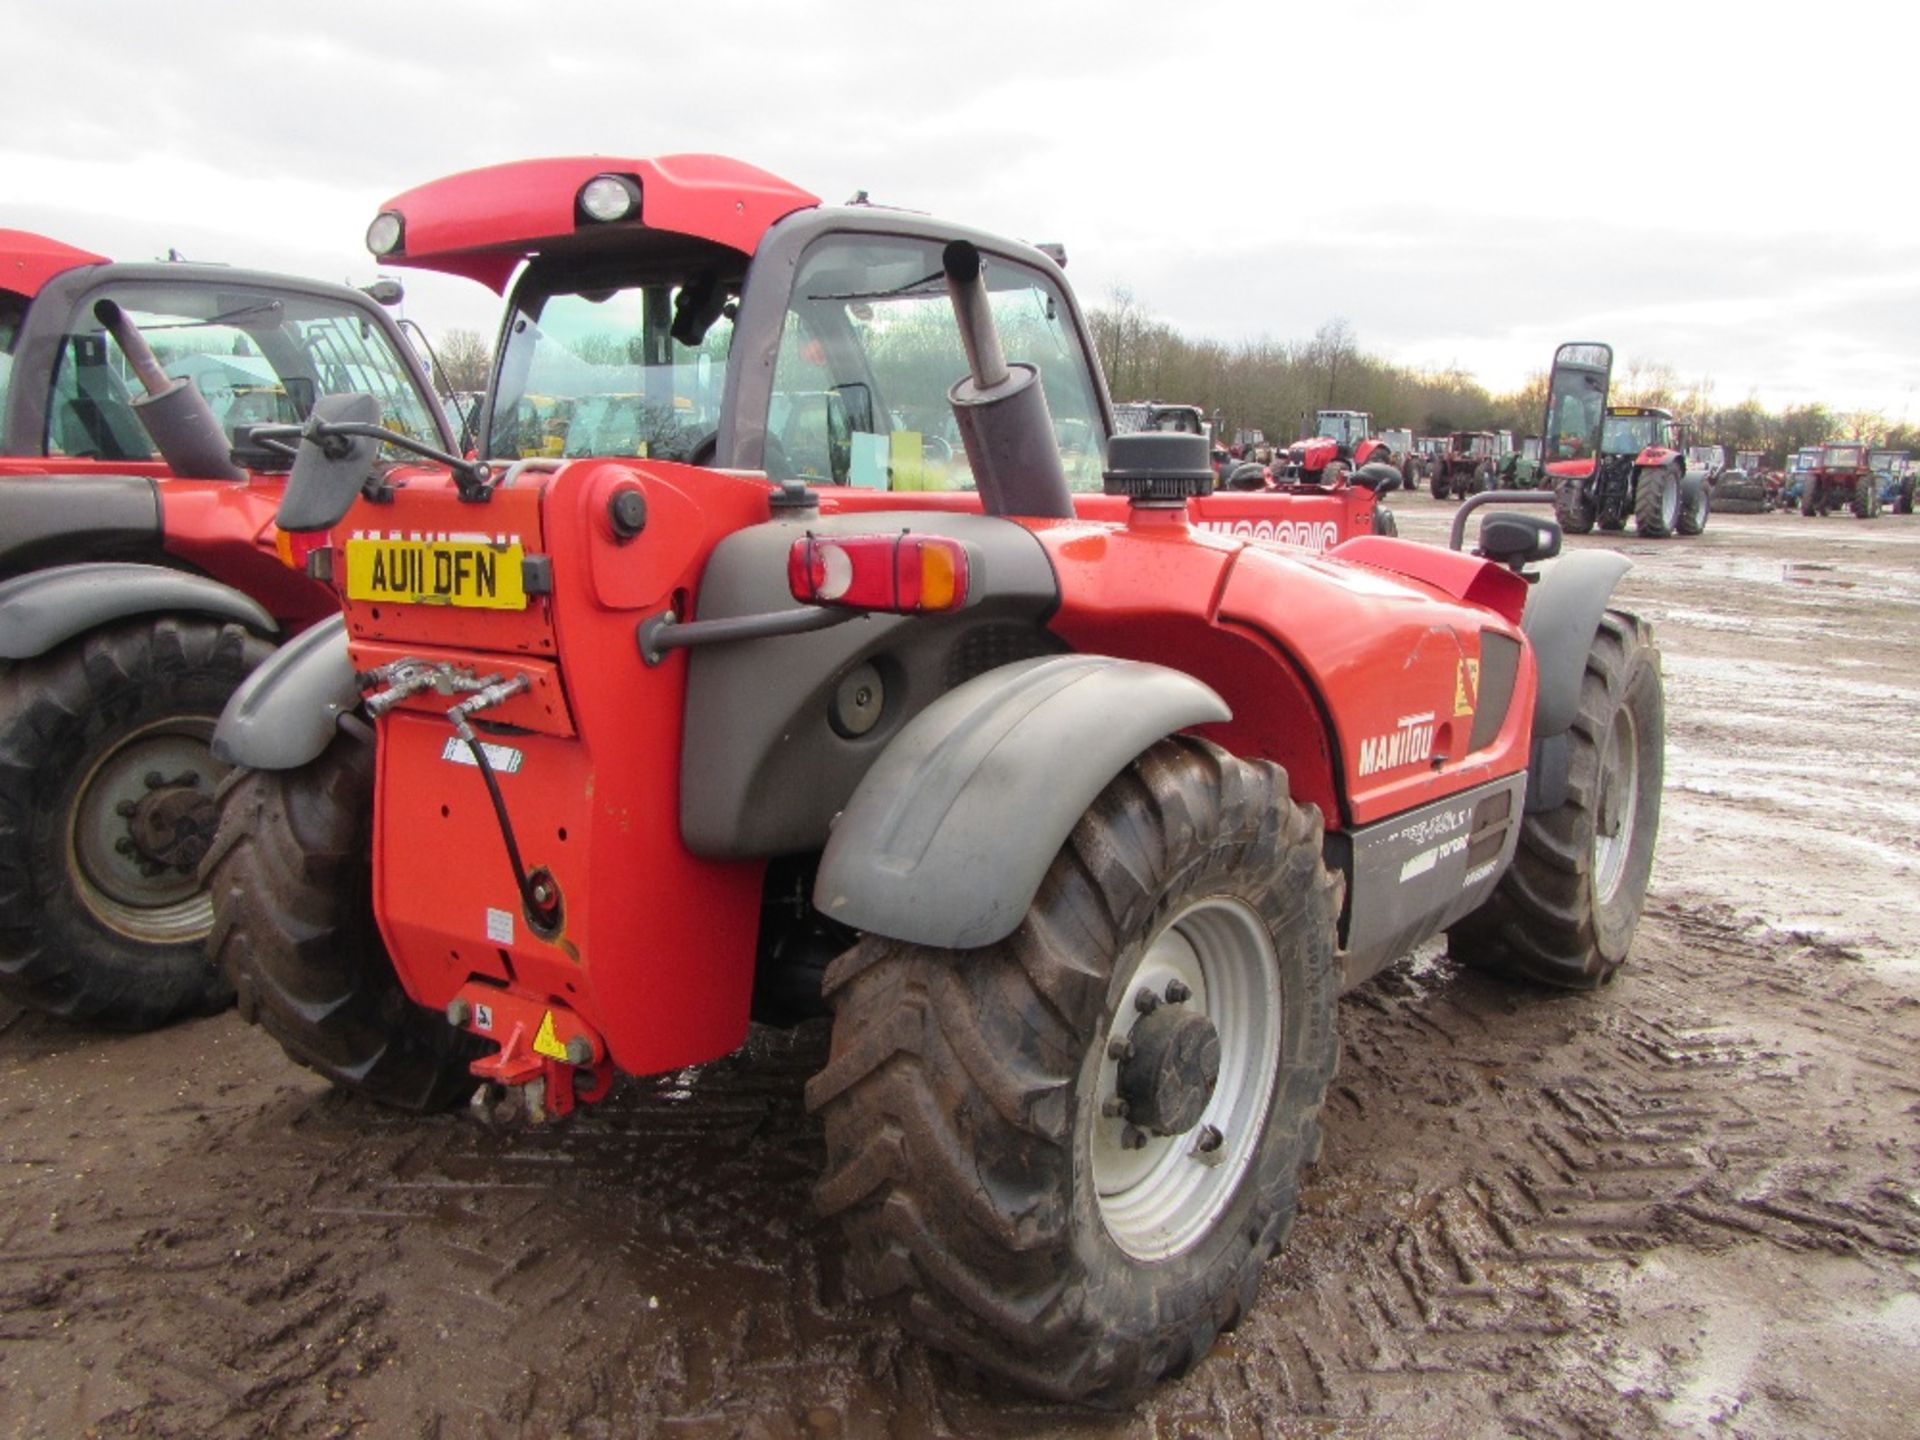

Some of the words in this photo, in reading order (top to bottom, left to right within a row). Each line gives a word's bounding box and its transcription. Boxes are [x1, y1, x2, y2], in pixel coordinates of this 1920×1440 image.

[371, 548, 423, 594] AU11
[433, 550, 496, 598] DFN
[1358, 709, 1435, 777] MANITOU
